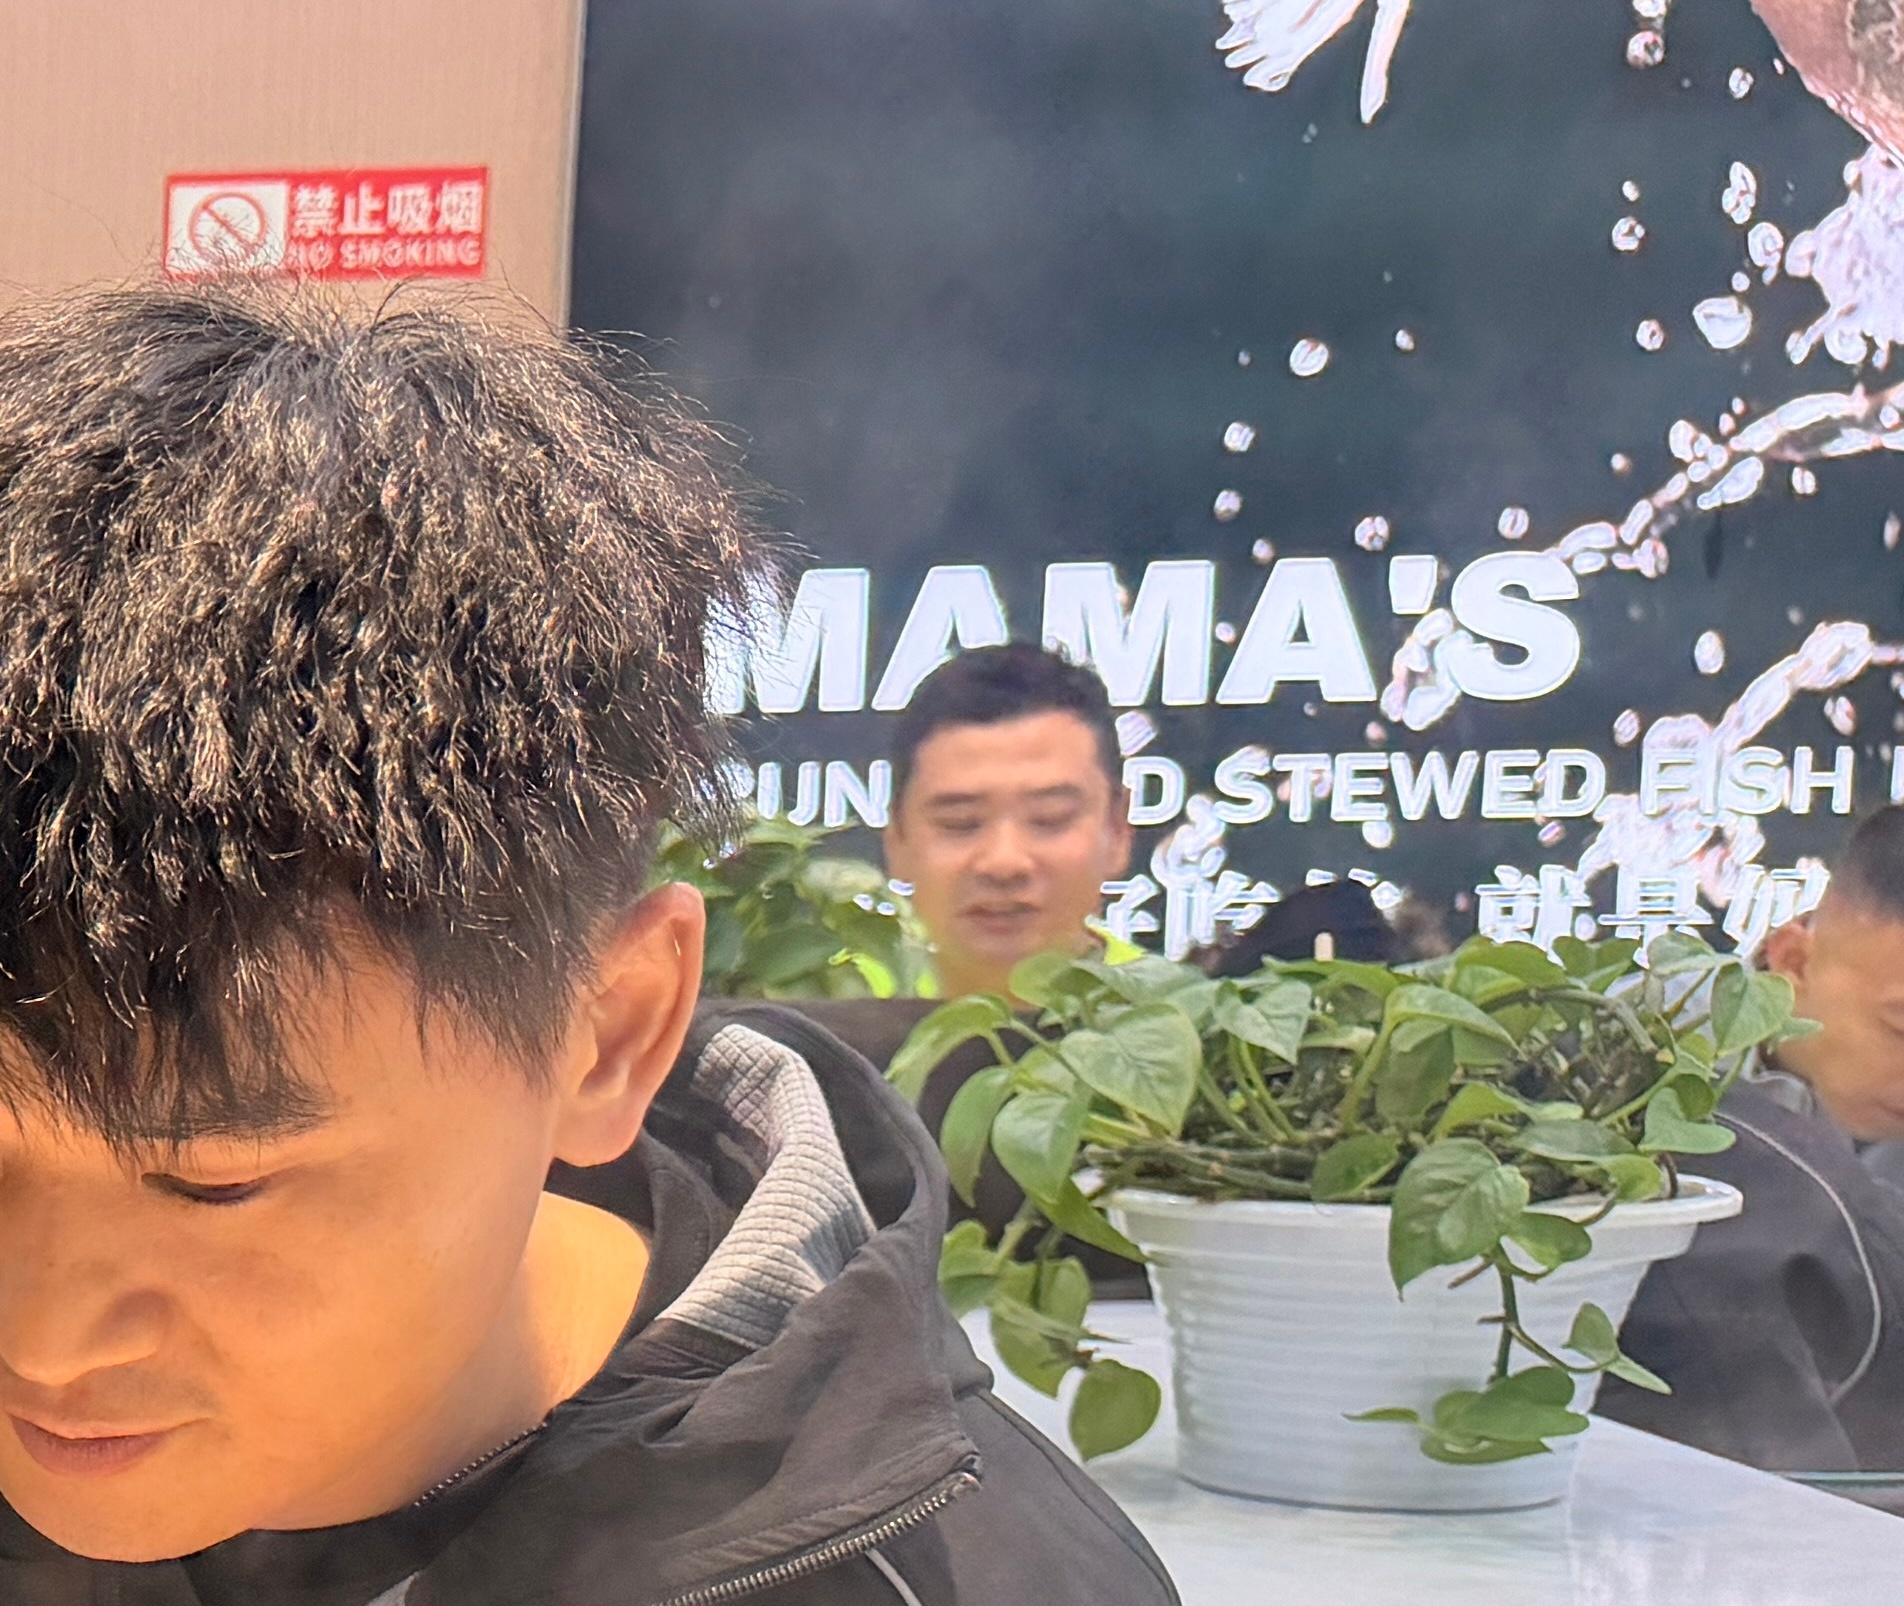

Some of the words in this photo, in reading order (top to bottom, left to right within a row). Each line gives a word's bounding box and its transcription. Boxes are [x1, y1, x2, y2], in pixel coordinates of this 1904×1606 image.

[293, 182, 484, 237] 禁止吸烟
[289, 240, 334, 270] NO
[340, 238, 482, 267] SMOKING
[1214, 745, 1607, 824] STEWED
[1640, 745, 1854, 816] FISH
